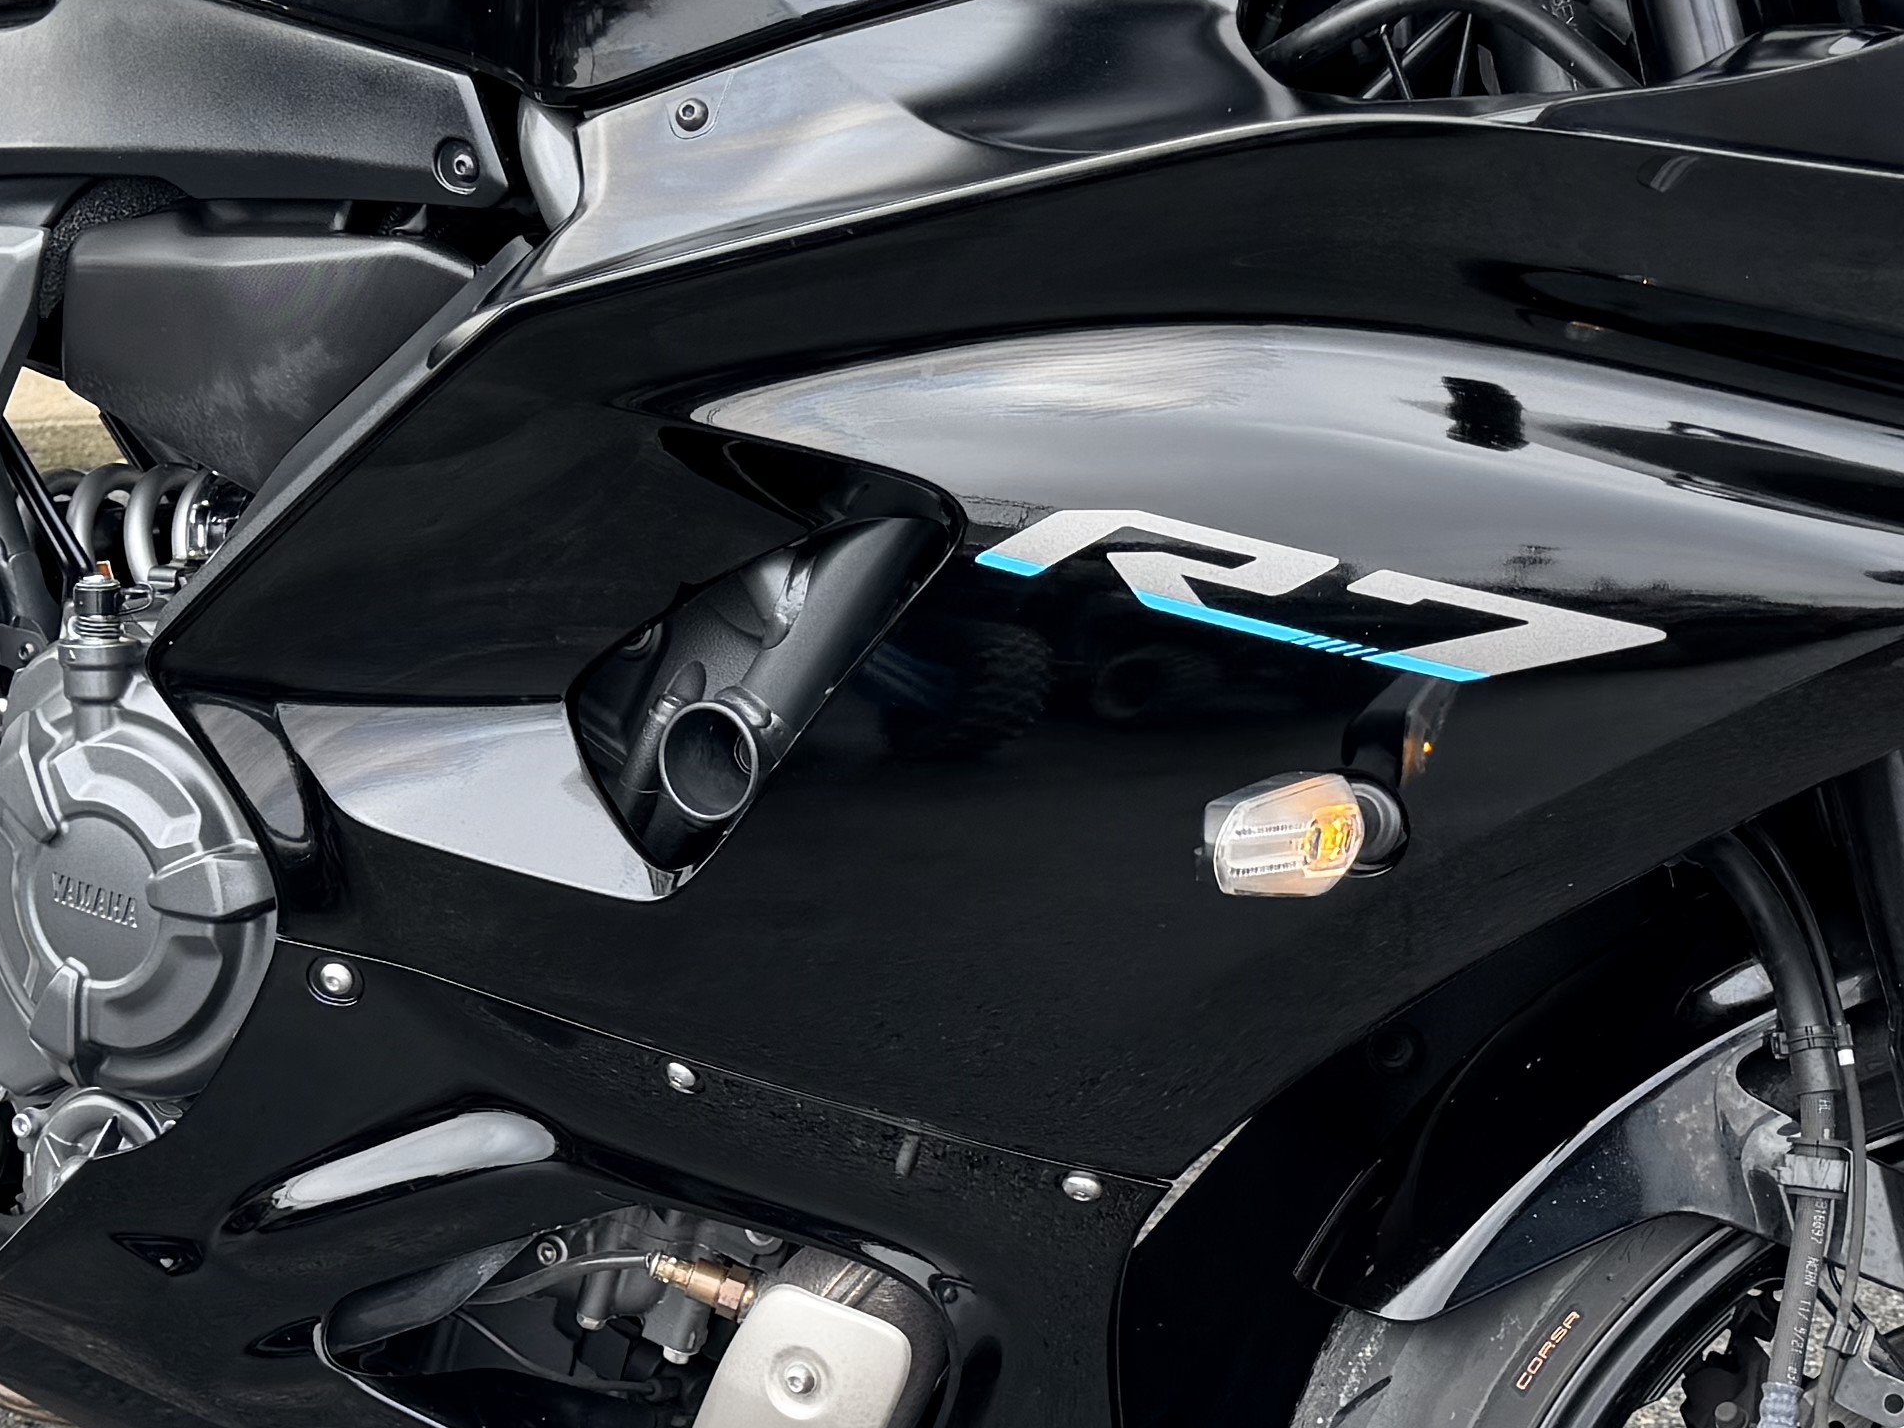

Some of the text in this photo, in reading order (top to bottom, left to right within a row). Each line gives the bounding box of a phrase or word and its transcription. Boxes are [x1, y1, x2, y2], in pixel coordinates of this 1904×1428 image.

[973, 508, 1668, 683] R7
[50, 871, 140, 929] YAMAHA
[1513, 1307, 1588, 1397] CORSA
